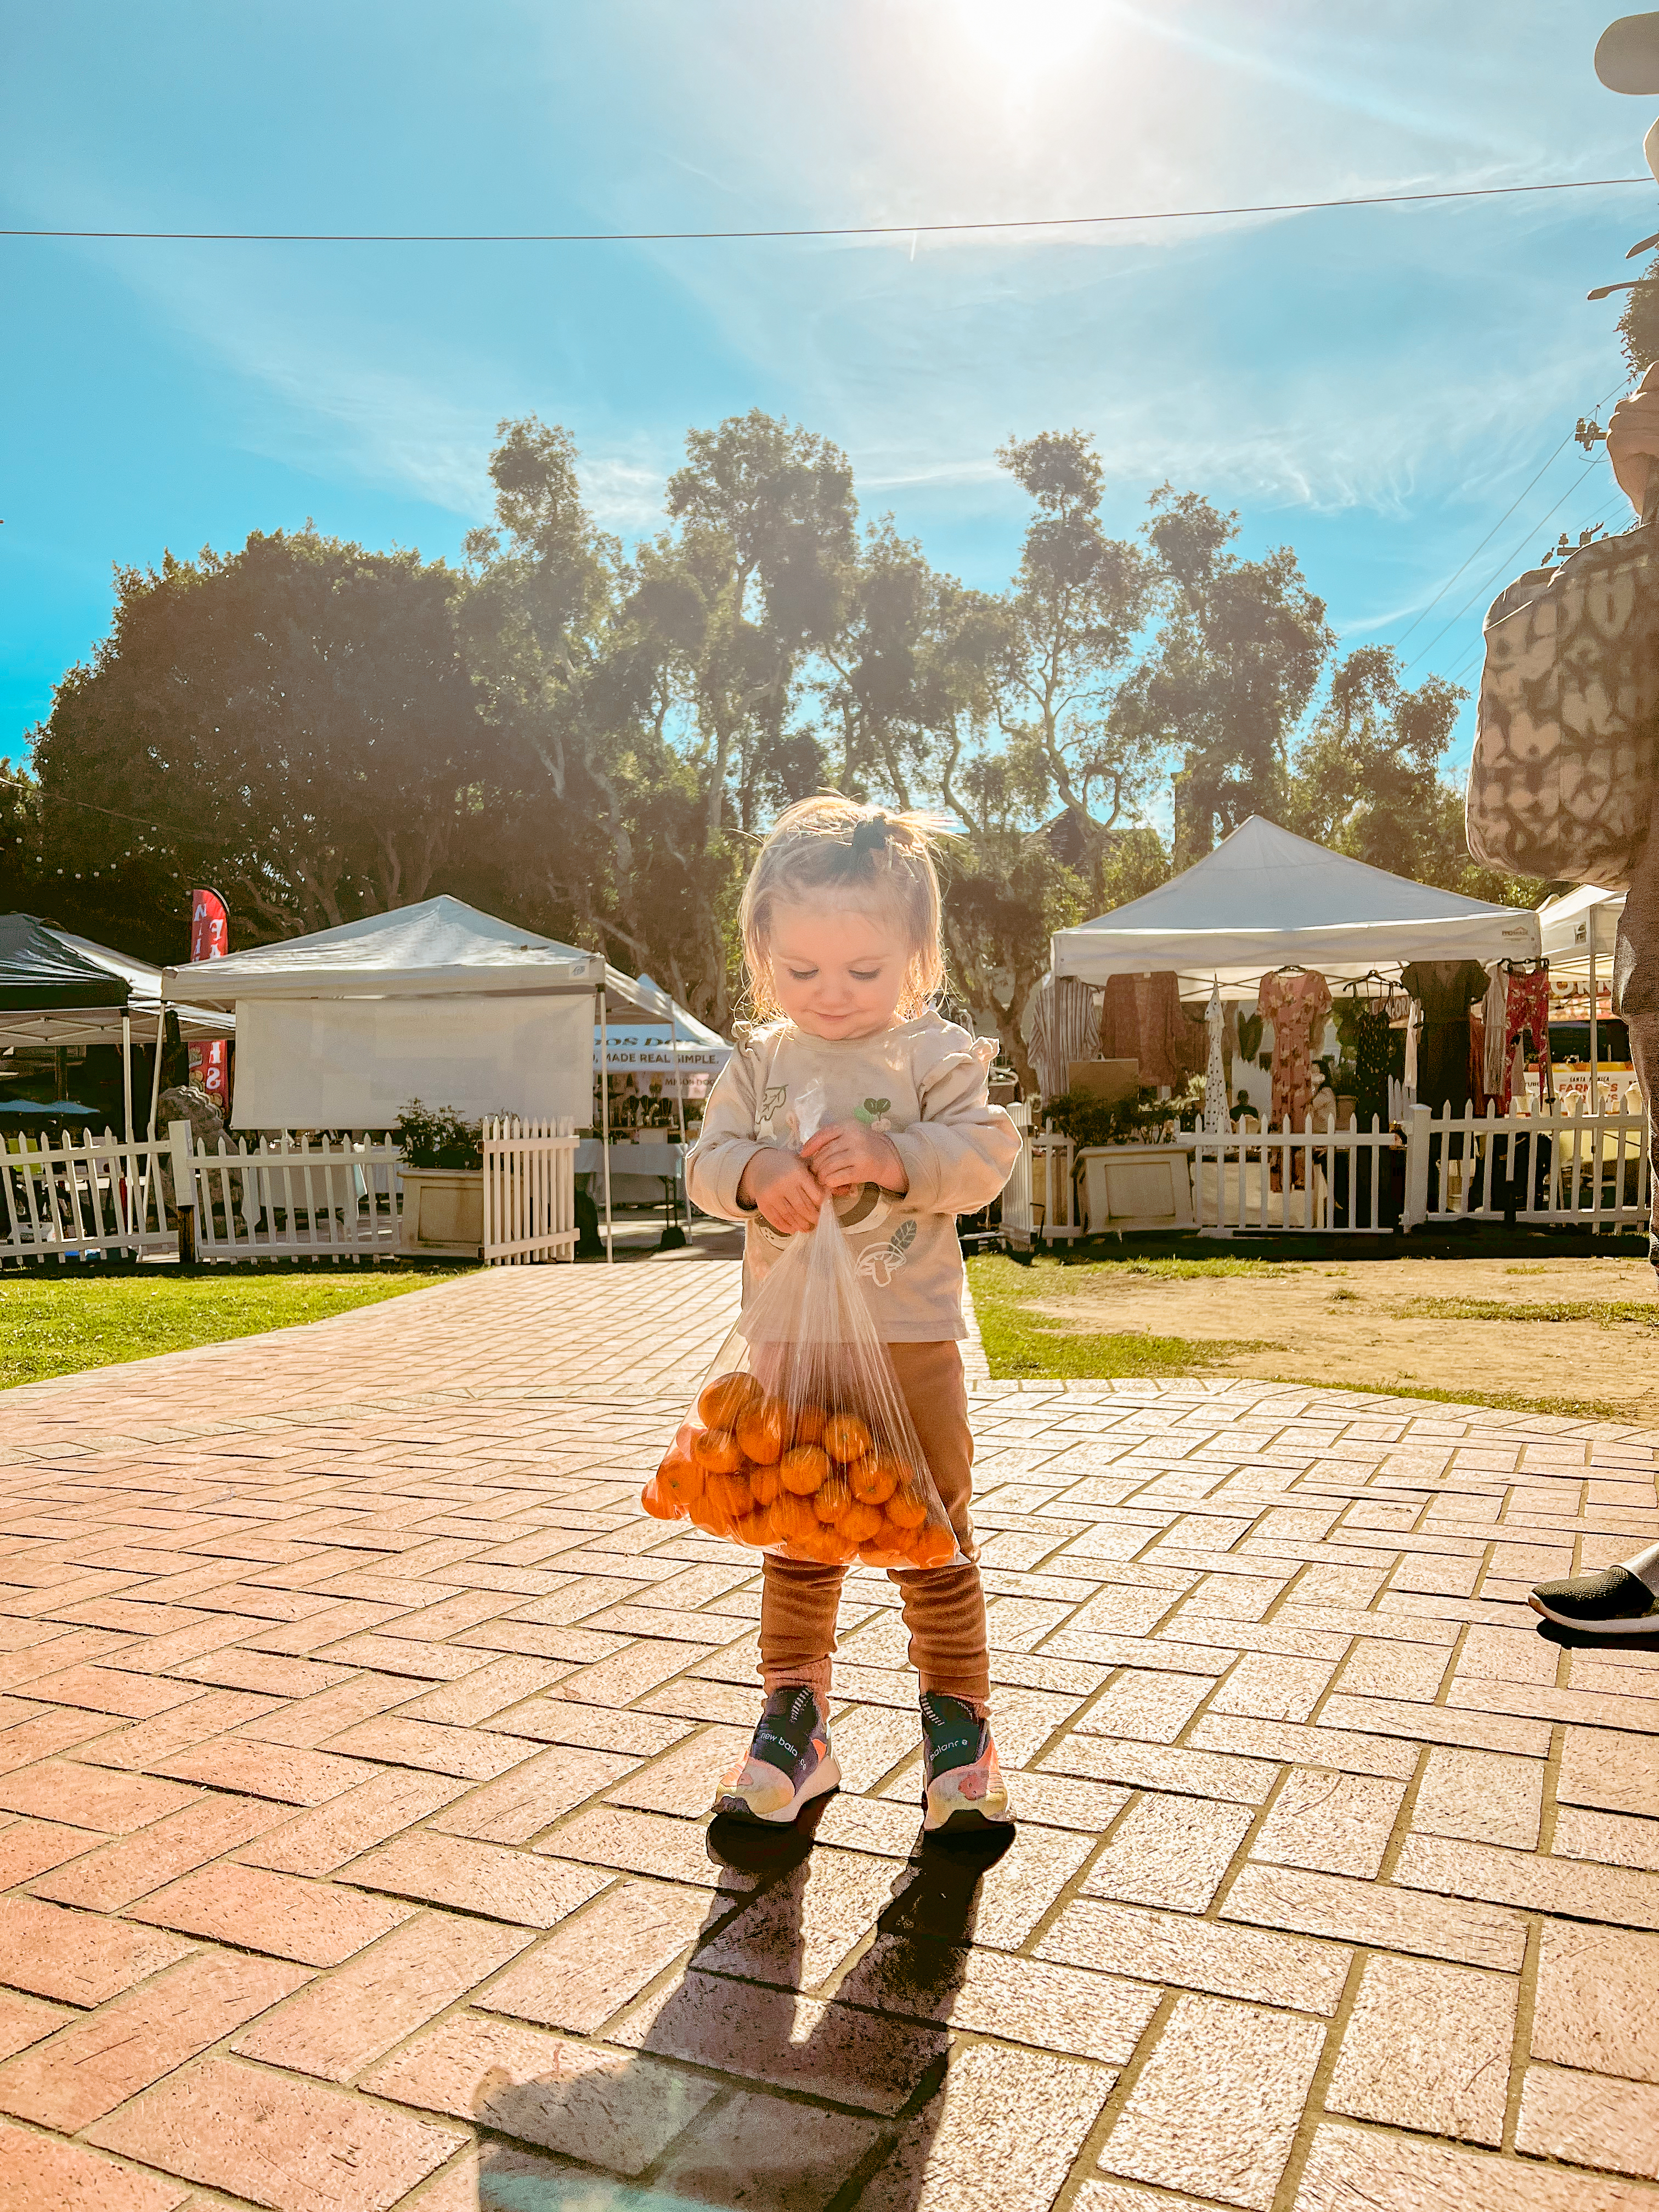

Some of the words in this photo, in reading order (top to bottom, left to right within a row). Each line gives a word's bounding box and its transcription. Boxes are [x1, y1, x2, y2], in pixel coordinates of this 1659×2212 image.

[606, 1053, 636, 1062] MADE
[640, 1053, 670, 1063] REAL
[760, 1733, 777, 1742] new
